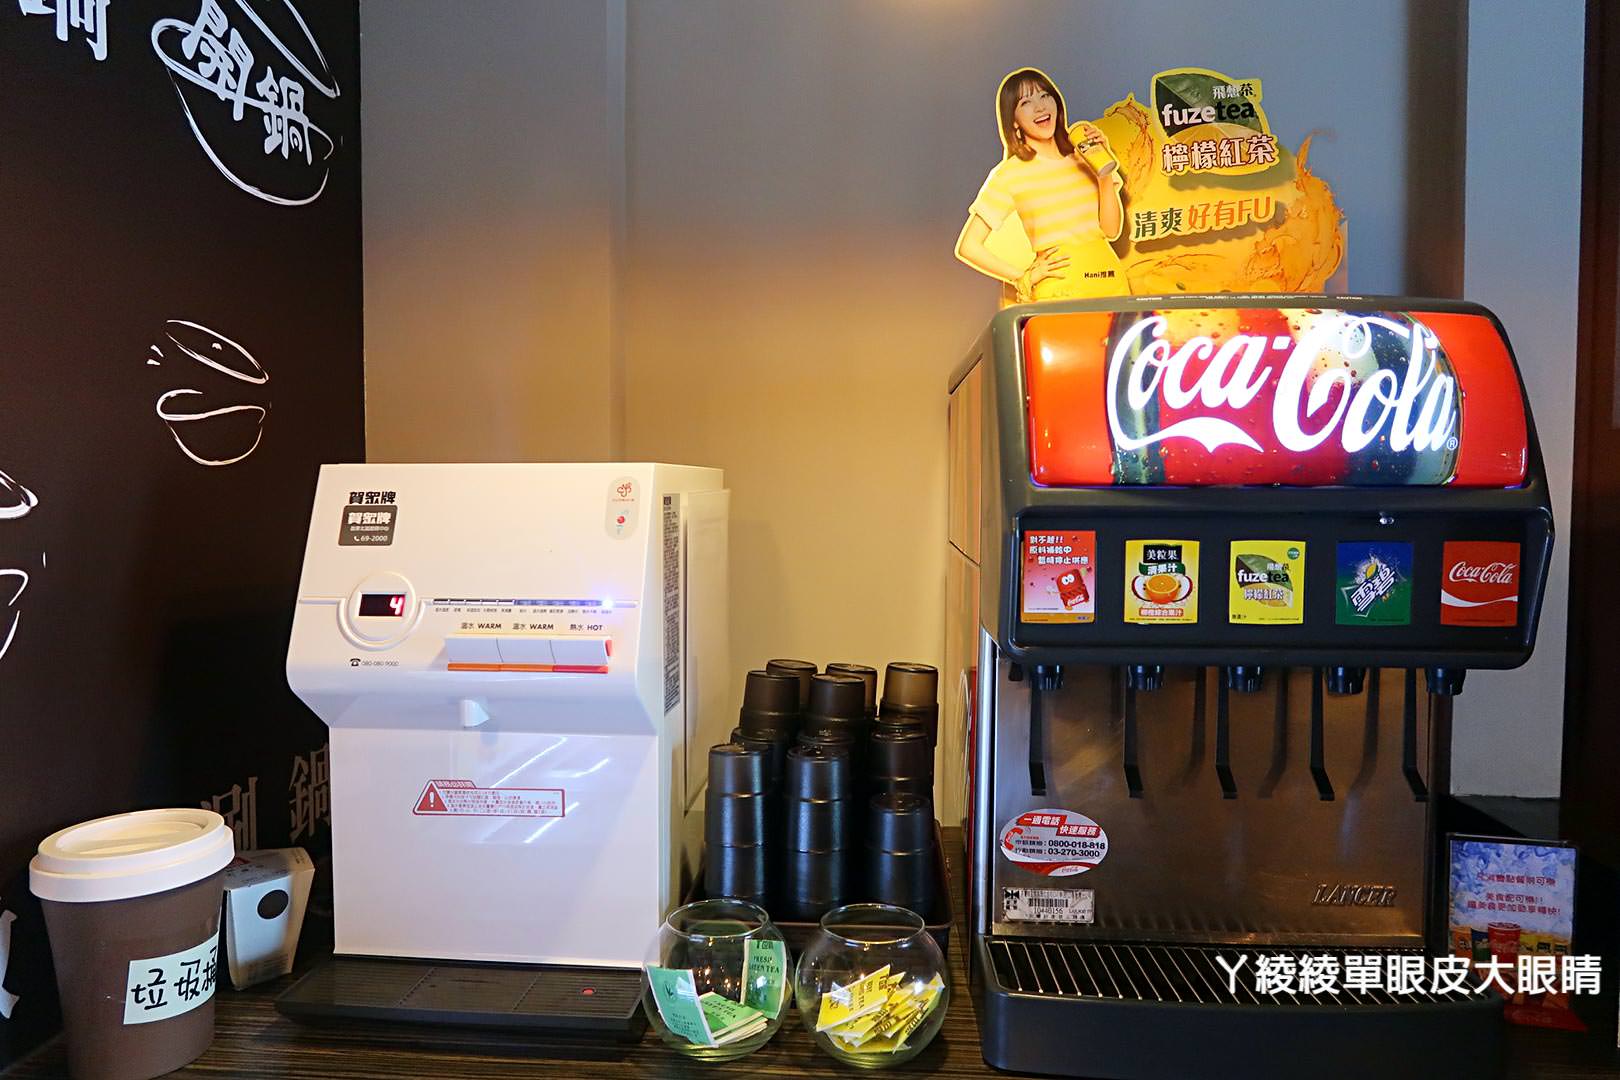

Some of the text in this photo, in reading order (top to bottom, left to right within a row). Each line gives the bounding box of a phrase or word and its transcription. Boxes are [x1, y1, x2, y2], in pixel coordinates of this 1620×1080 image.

[1161, 101, 1256, 127] fuzetea
[1162, 135, 1276, 173] 檸檬紅茶
[1134, 196, 1270, 239] 清爽 好有FU
[1107, 314, 1456, 453] Coca-Cola
[1237, 569, 1290, 583] fuzetea
[1448, 561, 1518, 584] Coca-Cola
[389, 596, 404, 615] 4
[1048, 840, 1106, 850] 0800-018-818
[1048, 848, 1100, 857] 03-270-3000
